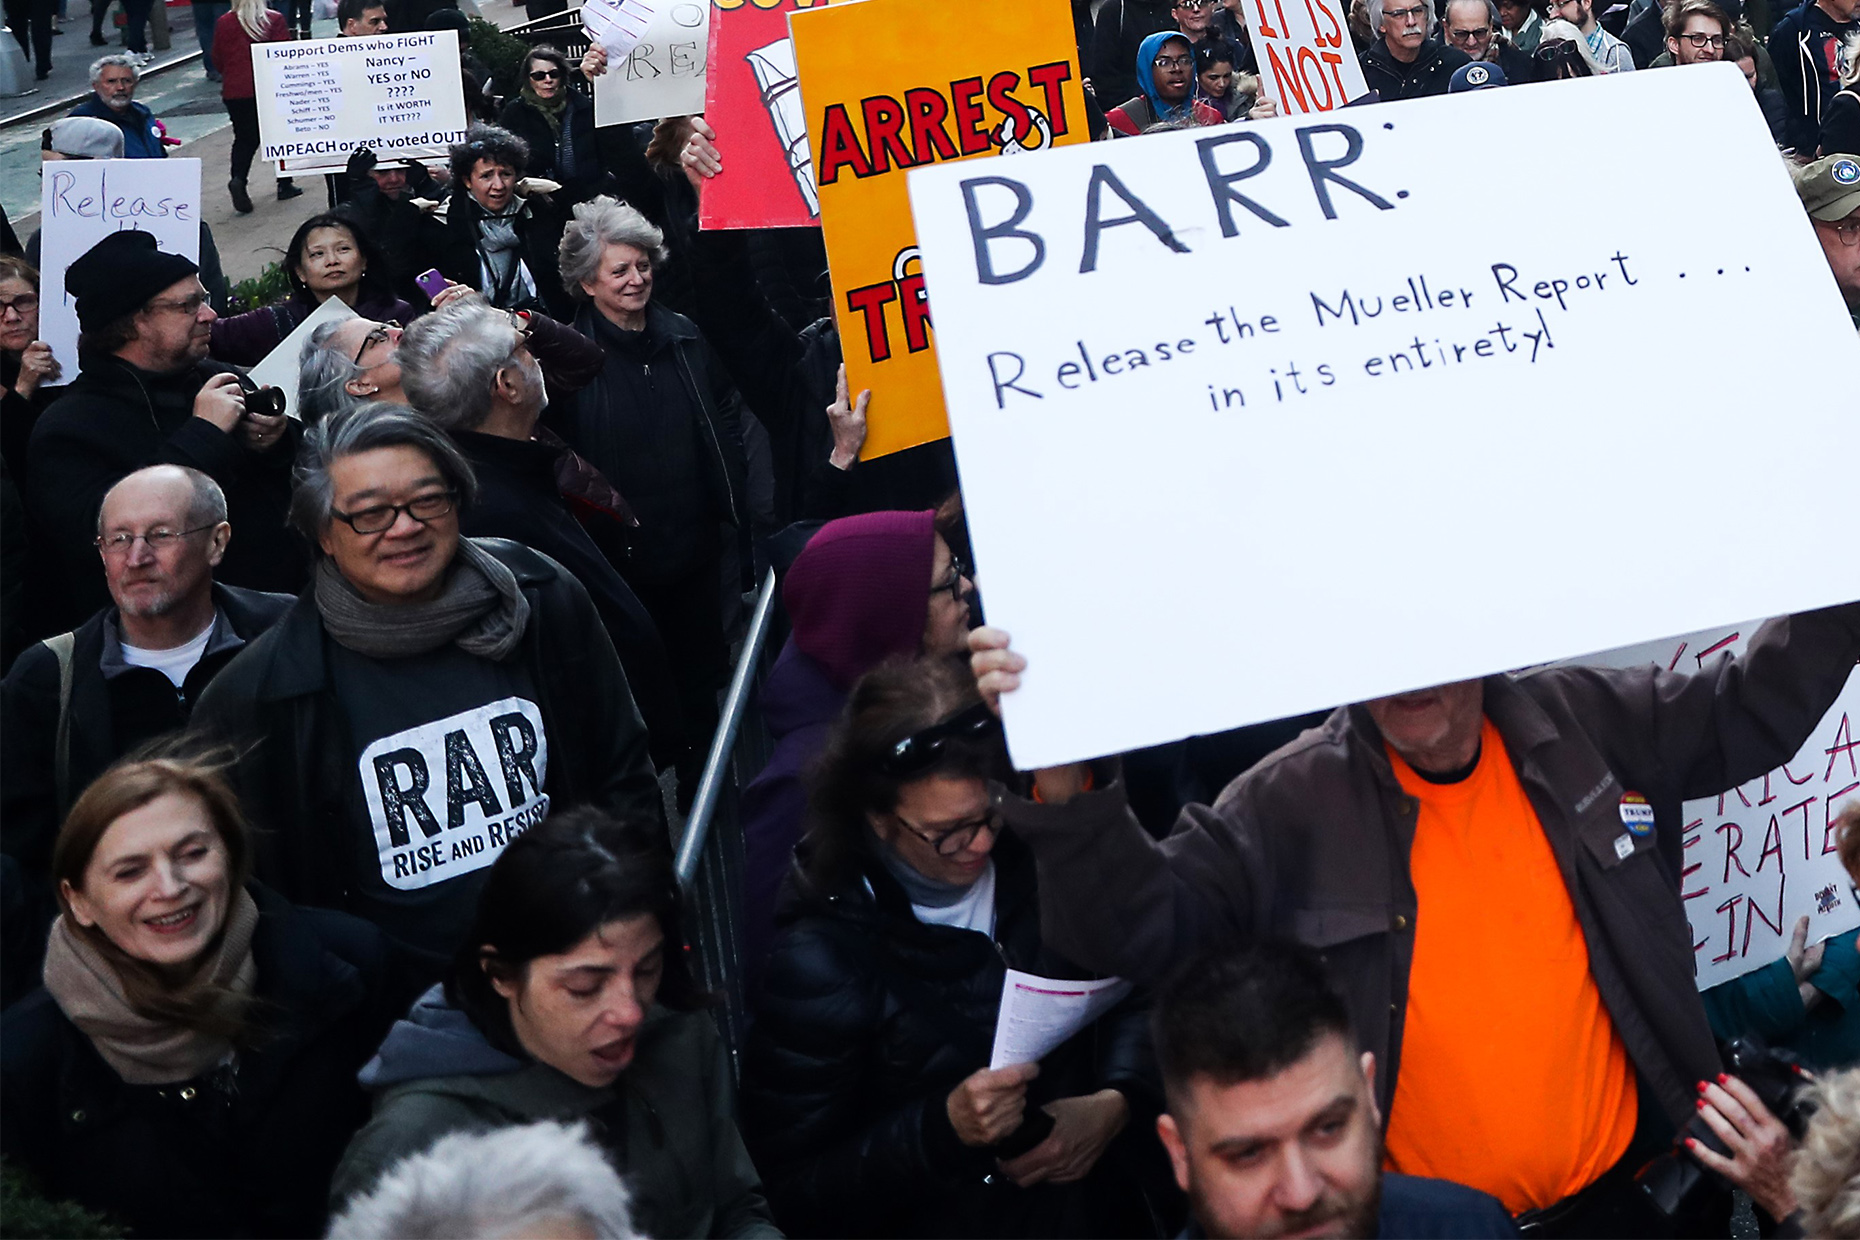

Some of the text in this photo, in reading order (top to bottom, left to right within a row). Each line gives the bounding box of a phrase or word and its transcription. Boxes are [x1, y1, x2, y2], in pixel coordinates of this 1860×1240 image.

[267, 35, 435, 59] I support Dems who FIGHT
[366, 56, 404, 67] Nancy
[368, 68, 431, 84] YES or NO
[387, 86, 415, 98] ????
[1266, 42, 1349, 114] NOT
[379, 113, 420, 124] IT YET???
[396, 100, 431, 109] WORTH
[818, 61, 1072, 188] ARREST
[266, 141, 336, 157] IMPEACH
[339, 141, 354, 151] or
[360, 137, 383, 149] get
[387, 133, 428, 148] voted
[52, 168, 193, 222] Release
[959, 122, 1411, 286] BARR:
[986, 250, 1638, 409] Release the Mueller Report
[1209, 309, 1554, 411] in its entirety!
[371, 709, 546, 848] RAR
[392, 841, 448, 879] RISE
[451, 834, 485, 862] AND
